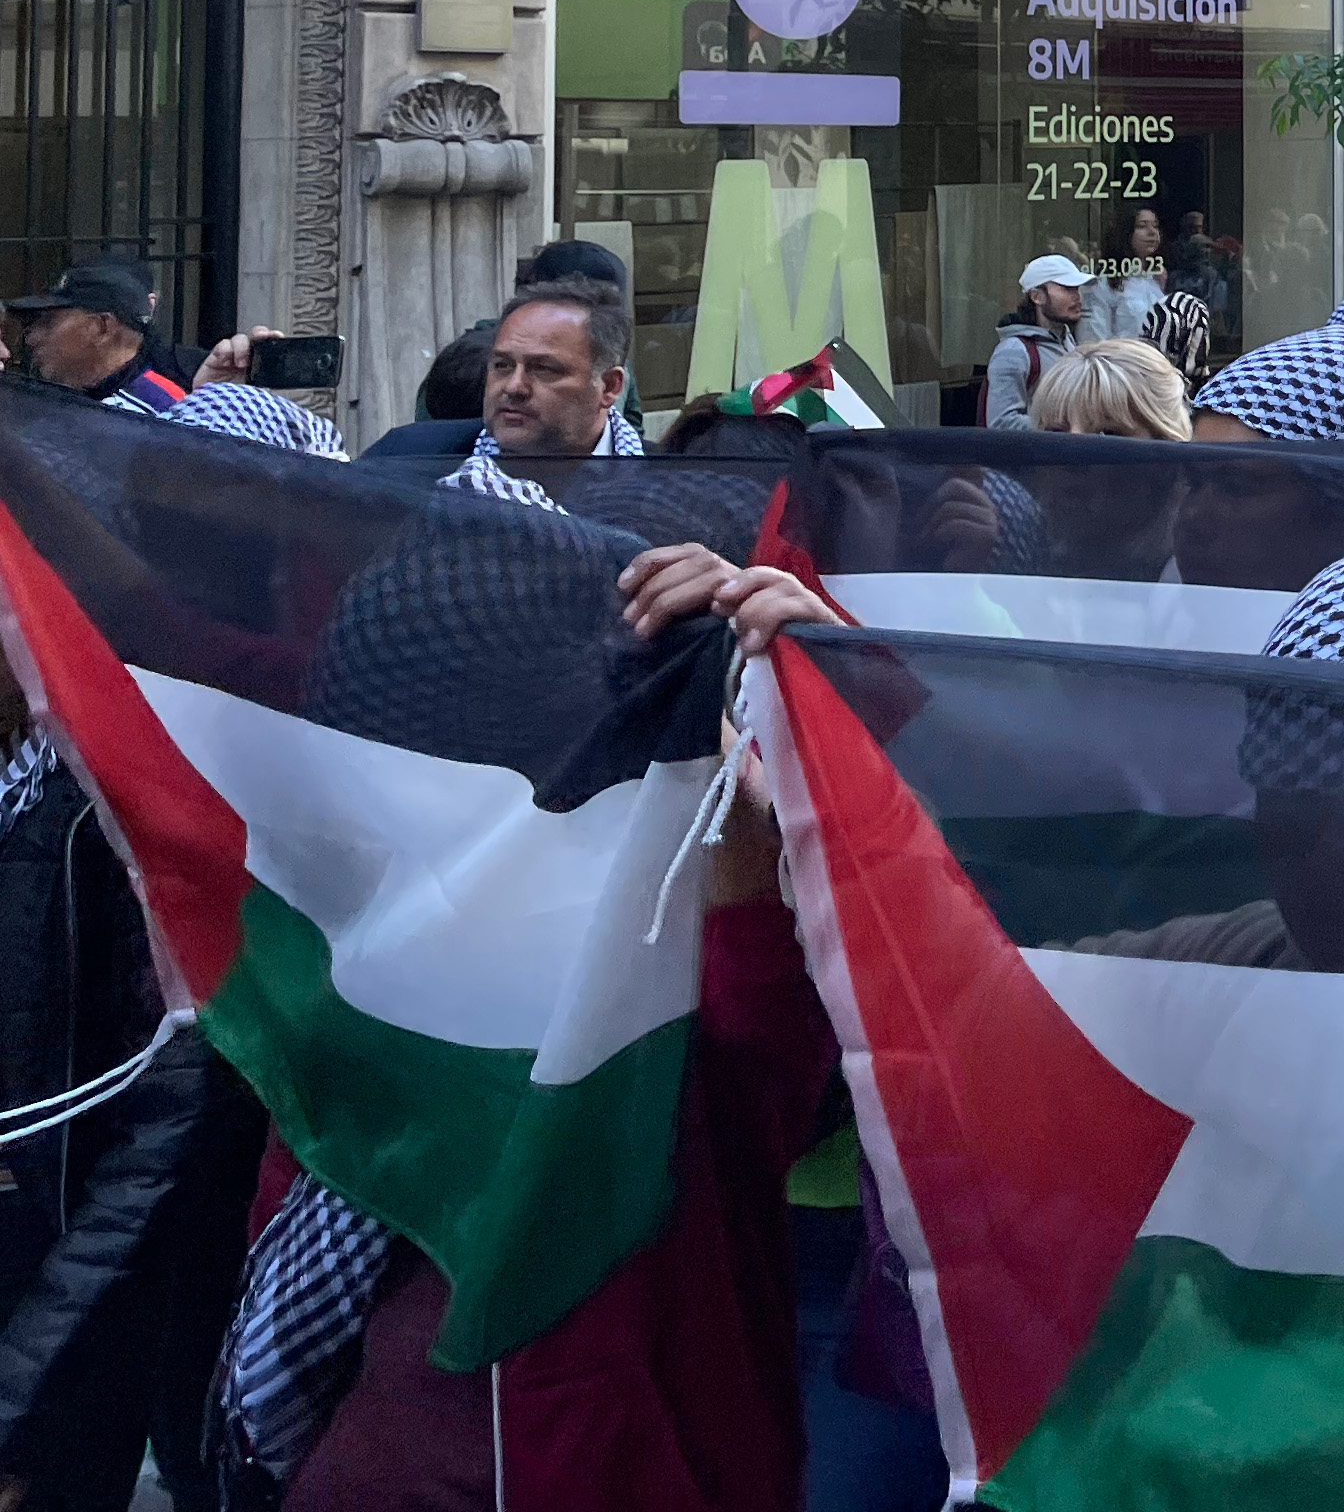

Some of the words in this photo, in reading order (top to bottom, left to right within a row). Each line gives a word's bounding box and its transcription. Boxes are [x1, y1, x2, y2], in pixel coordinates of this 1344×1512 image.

[1027, 37, 1090, 81] 8M
[1028, 102, 1175, 144] Ediciones
[1026, 160, 1157, 201] 21-22-23
[1099, 255, 1164, 279] 23.09.23
